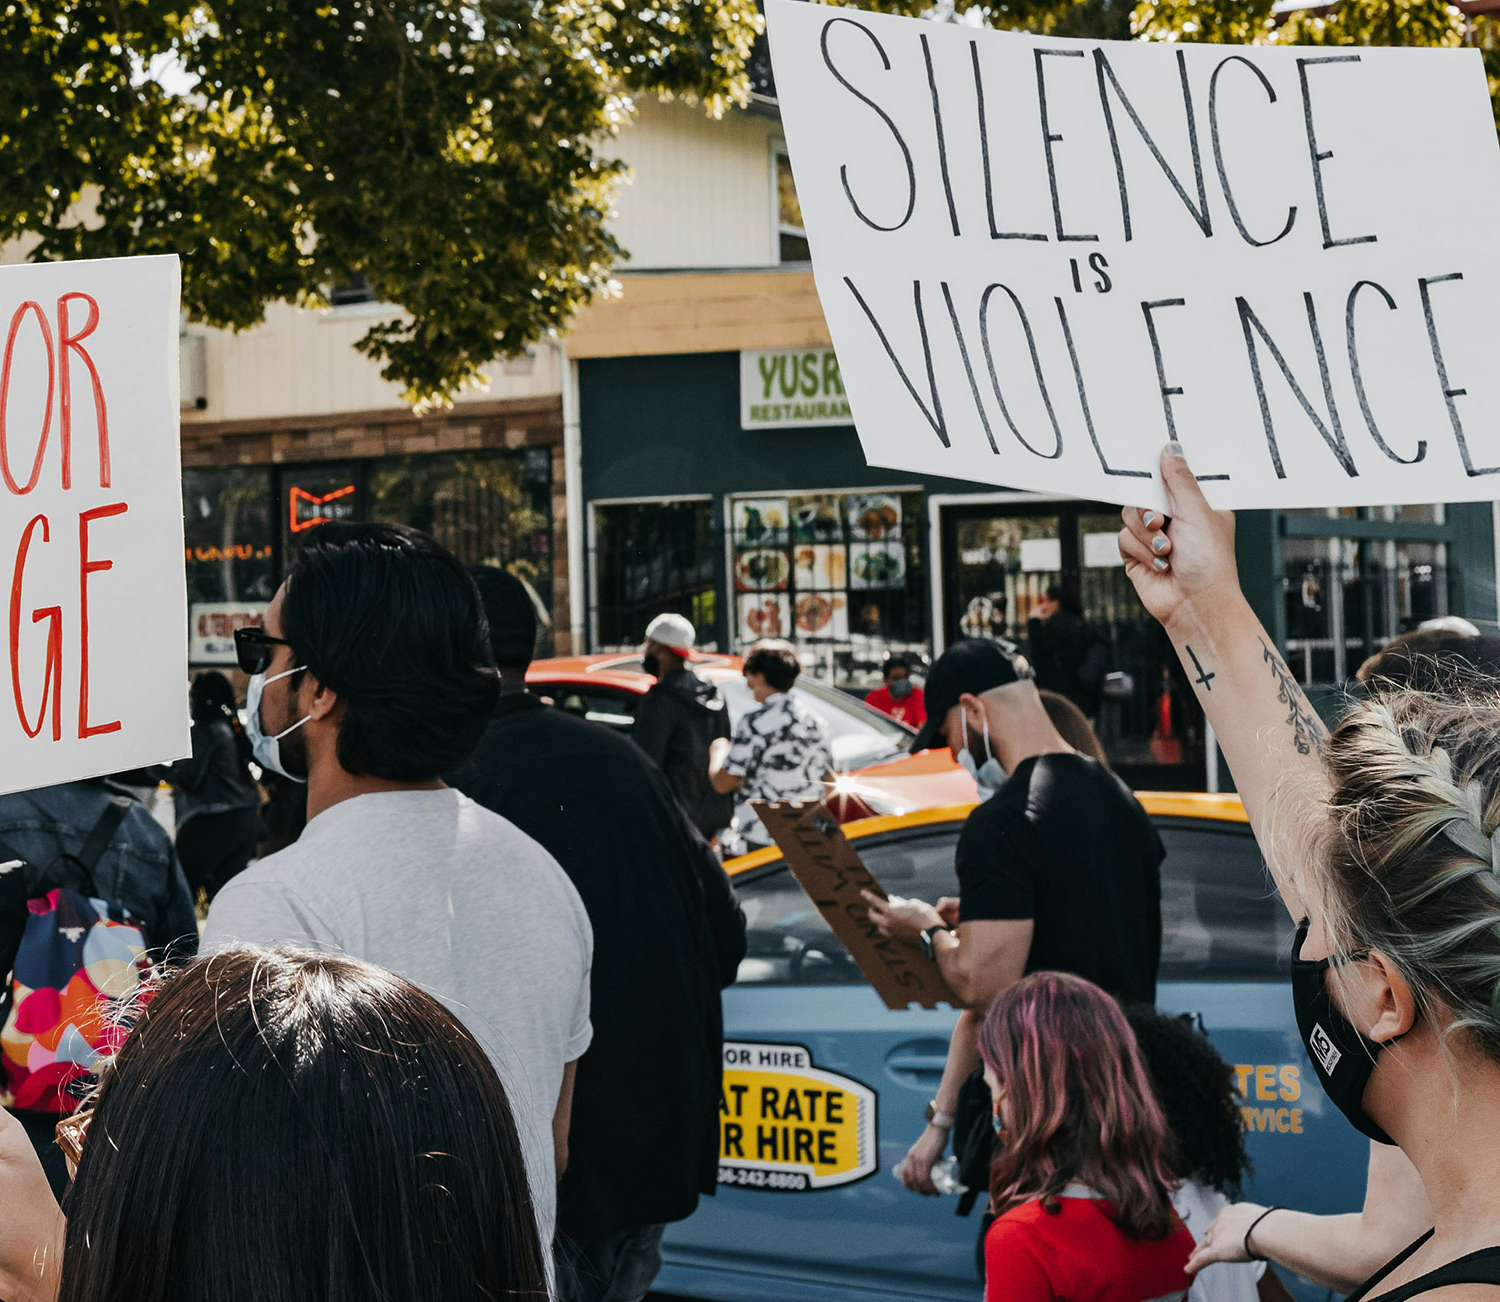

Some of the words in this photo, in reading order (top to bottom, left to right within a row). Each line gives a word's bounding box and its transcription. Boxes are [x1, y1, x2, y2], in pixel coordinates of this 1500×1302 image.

[820, 18, 1378, 249] SILENCE
[1070, 252, 1112, 293] IS
[758, 352, 844, 398] YUSR
[843, 273, 1500, 480] VIOLENCE
[759, 1051, 805, 1068] HIRE
[1233, 1064, 1301, 1101] TES
[761, 1086, 844, 1124] RATE
[757, 1125, 837, 1165] HIRE
